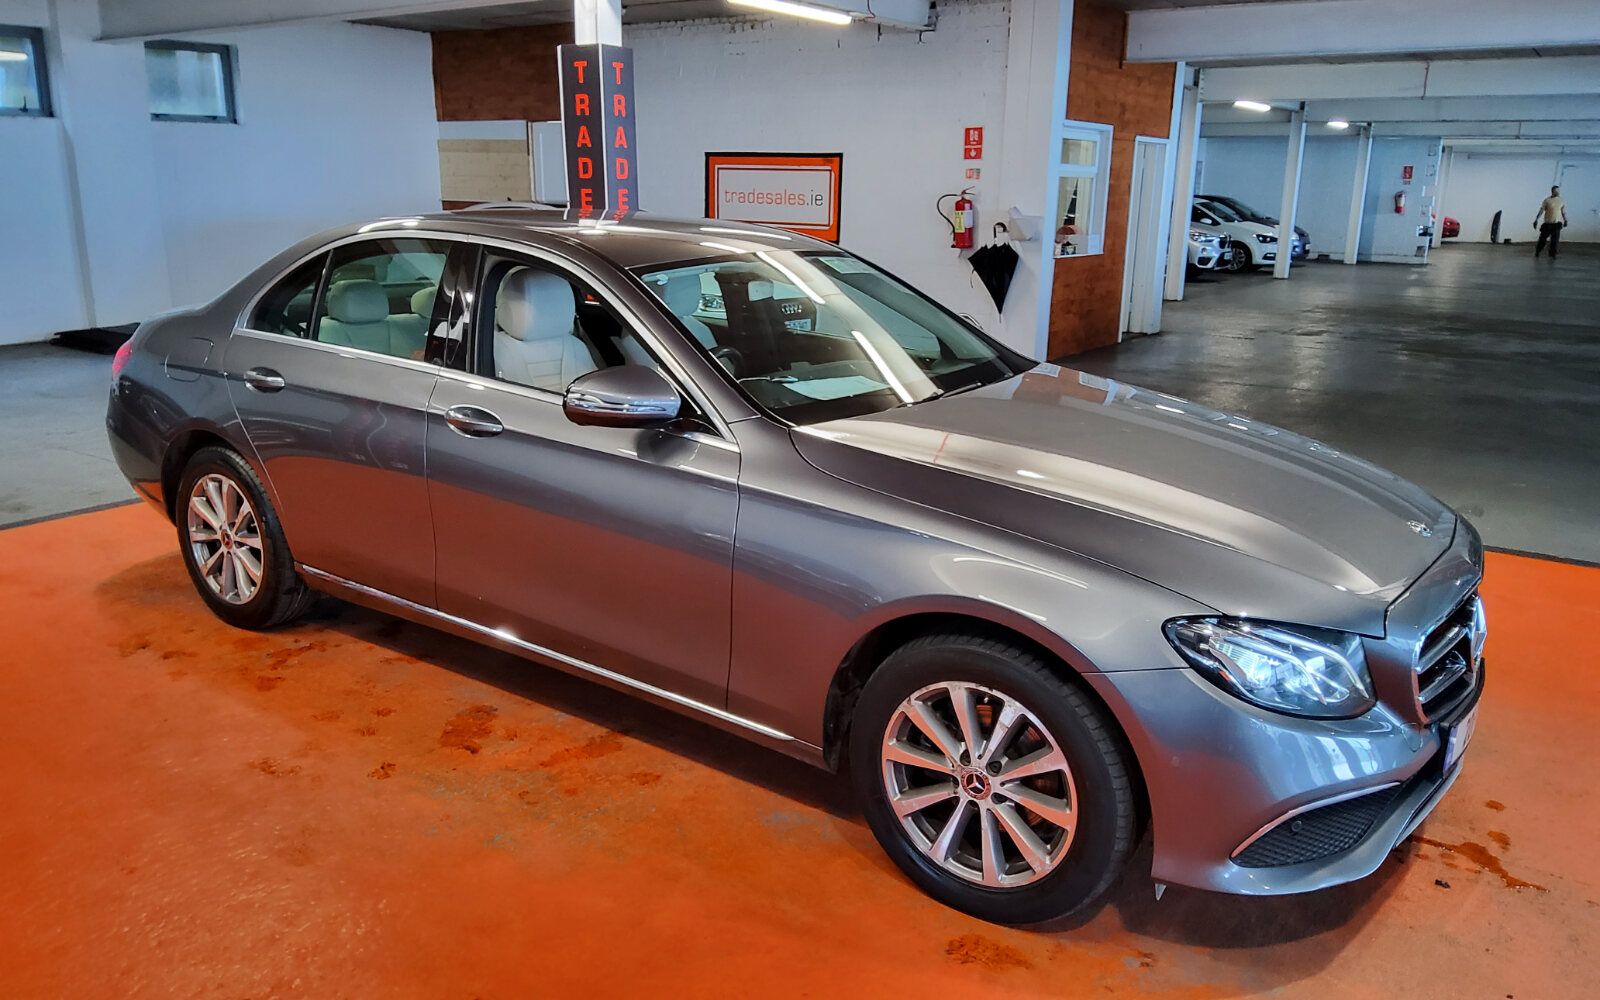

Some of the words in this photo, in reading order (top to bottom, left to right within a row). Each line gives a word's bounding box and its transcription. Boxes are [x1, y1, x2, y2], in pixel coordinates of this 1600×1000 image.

[574, 61, 593, 210] TRADE
[613, 62, 629, 210] TRADE
[725, 188, 824, 207] tradesales.ie
